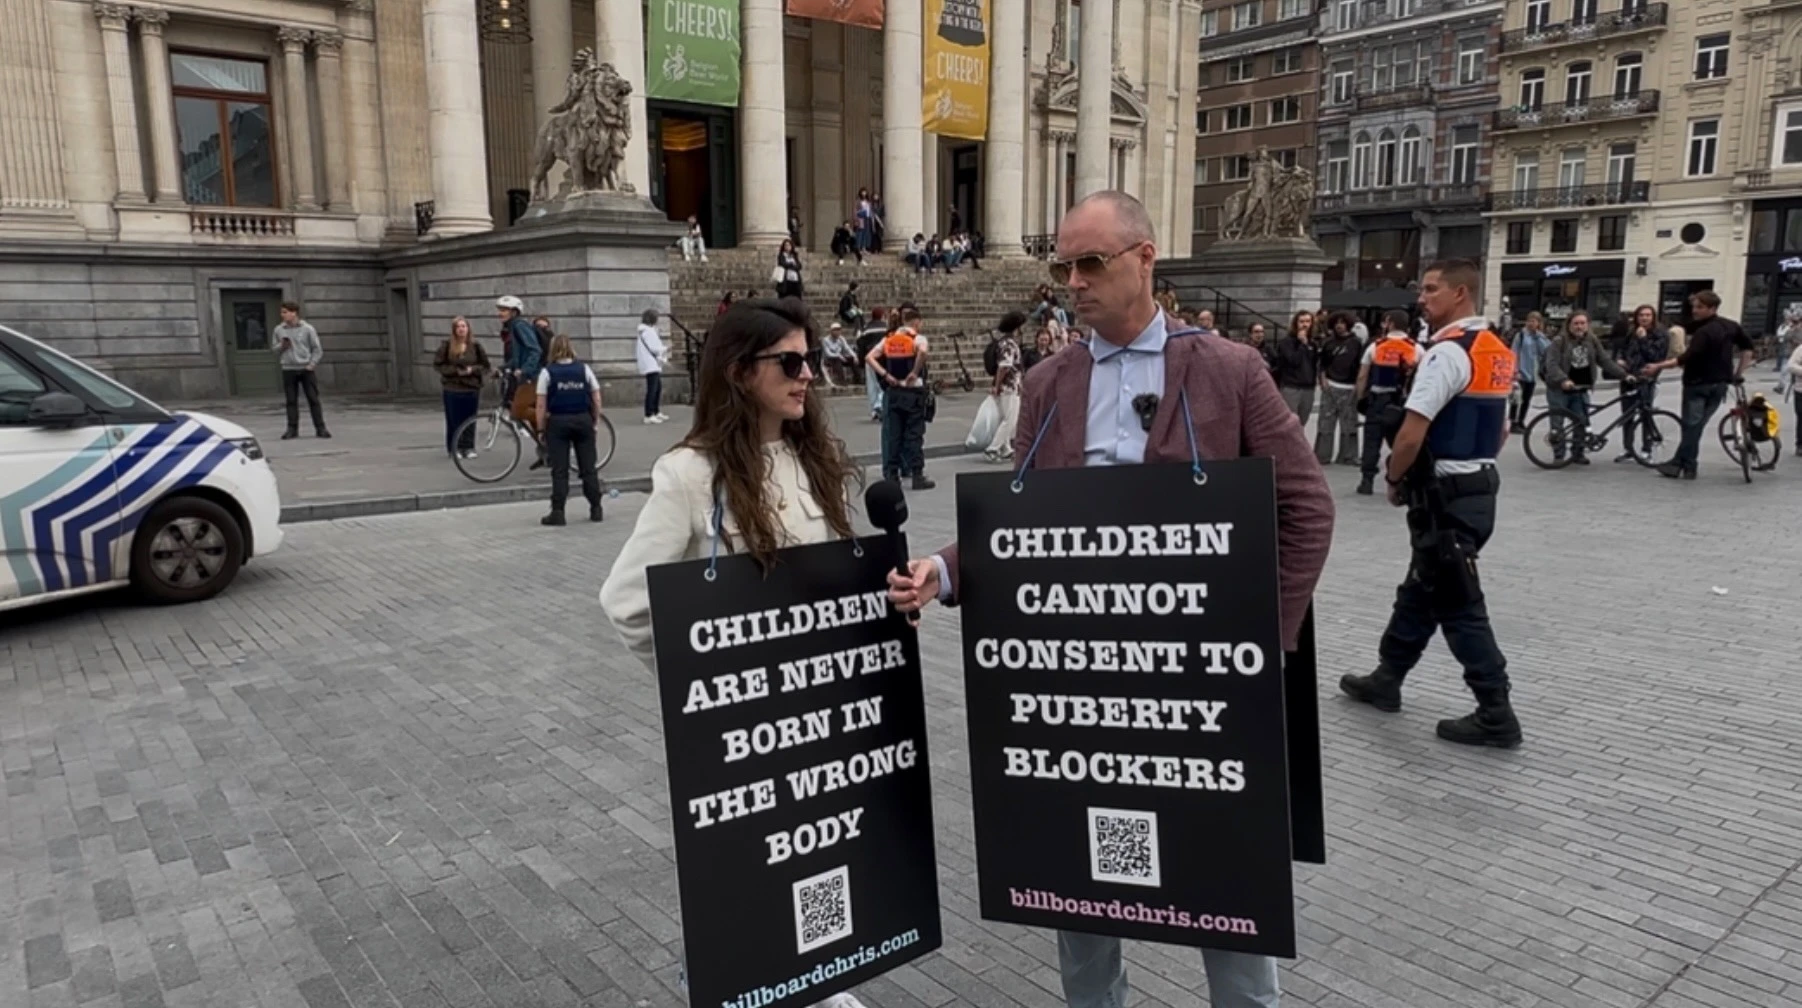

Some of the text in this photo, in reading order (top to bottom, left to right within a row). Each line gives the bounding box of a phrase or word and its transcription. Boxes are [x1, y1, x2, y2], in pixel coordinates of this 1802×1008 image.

[664, 0, 732, 41] CHEERS!
[937, 51, 984, 86] CHEERS!
[990, 522, 1234, 559] CHILDREN
[690, 590, 889, 652] CHILDREN
[1016, 582, 1208, 615] CANNOT
[683, 639, 906, 714] ARE NEVER
[975, 638, 1265, 676] CONSENT TO
[721, 695, 883, 763] BORN IN
[1010, 693, 1228, 732] PUBERTY
[689, 739, 917, 829] THE WRONG
[1003, 746, 1246, 792] BLOCKERS
[765, 808, 864, 865] BODY
[1009, 887, 1258, 936] billboardchris.com
